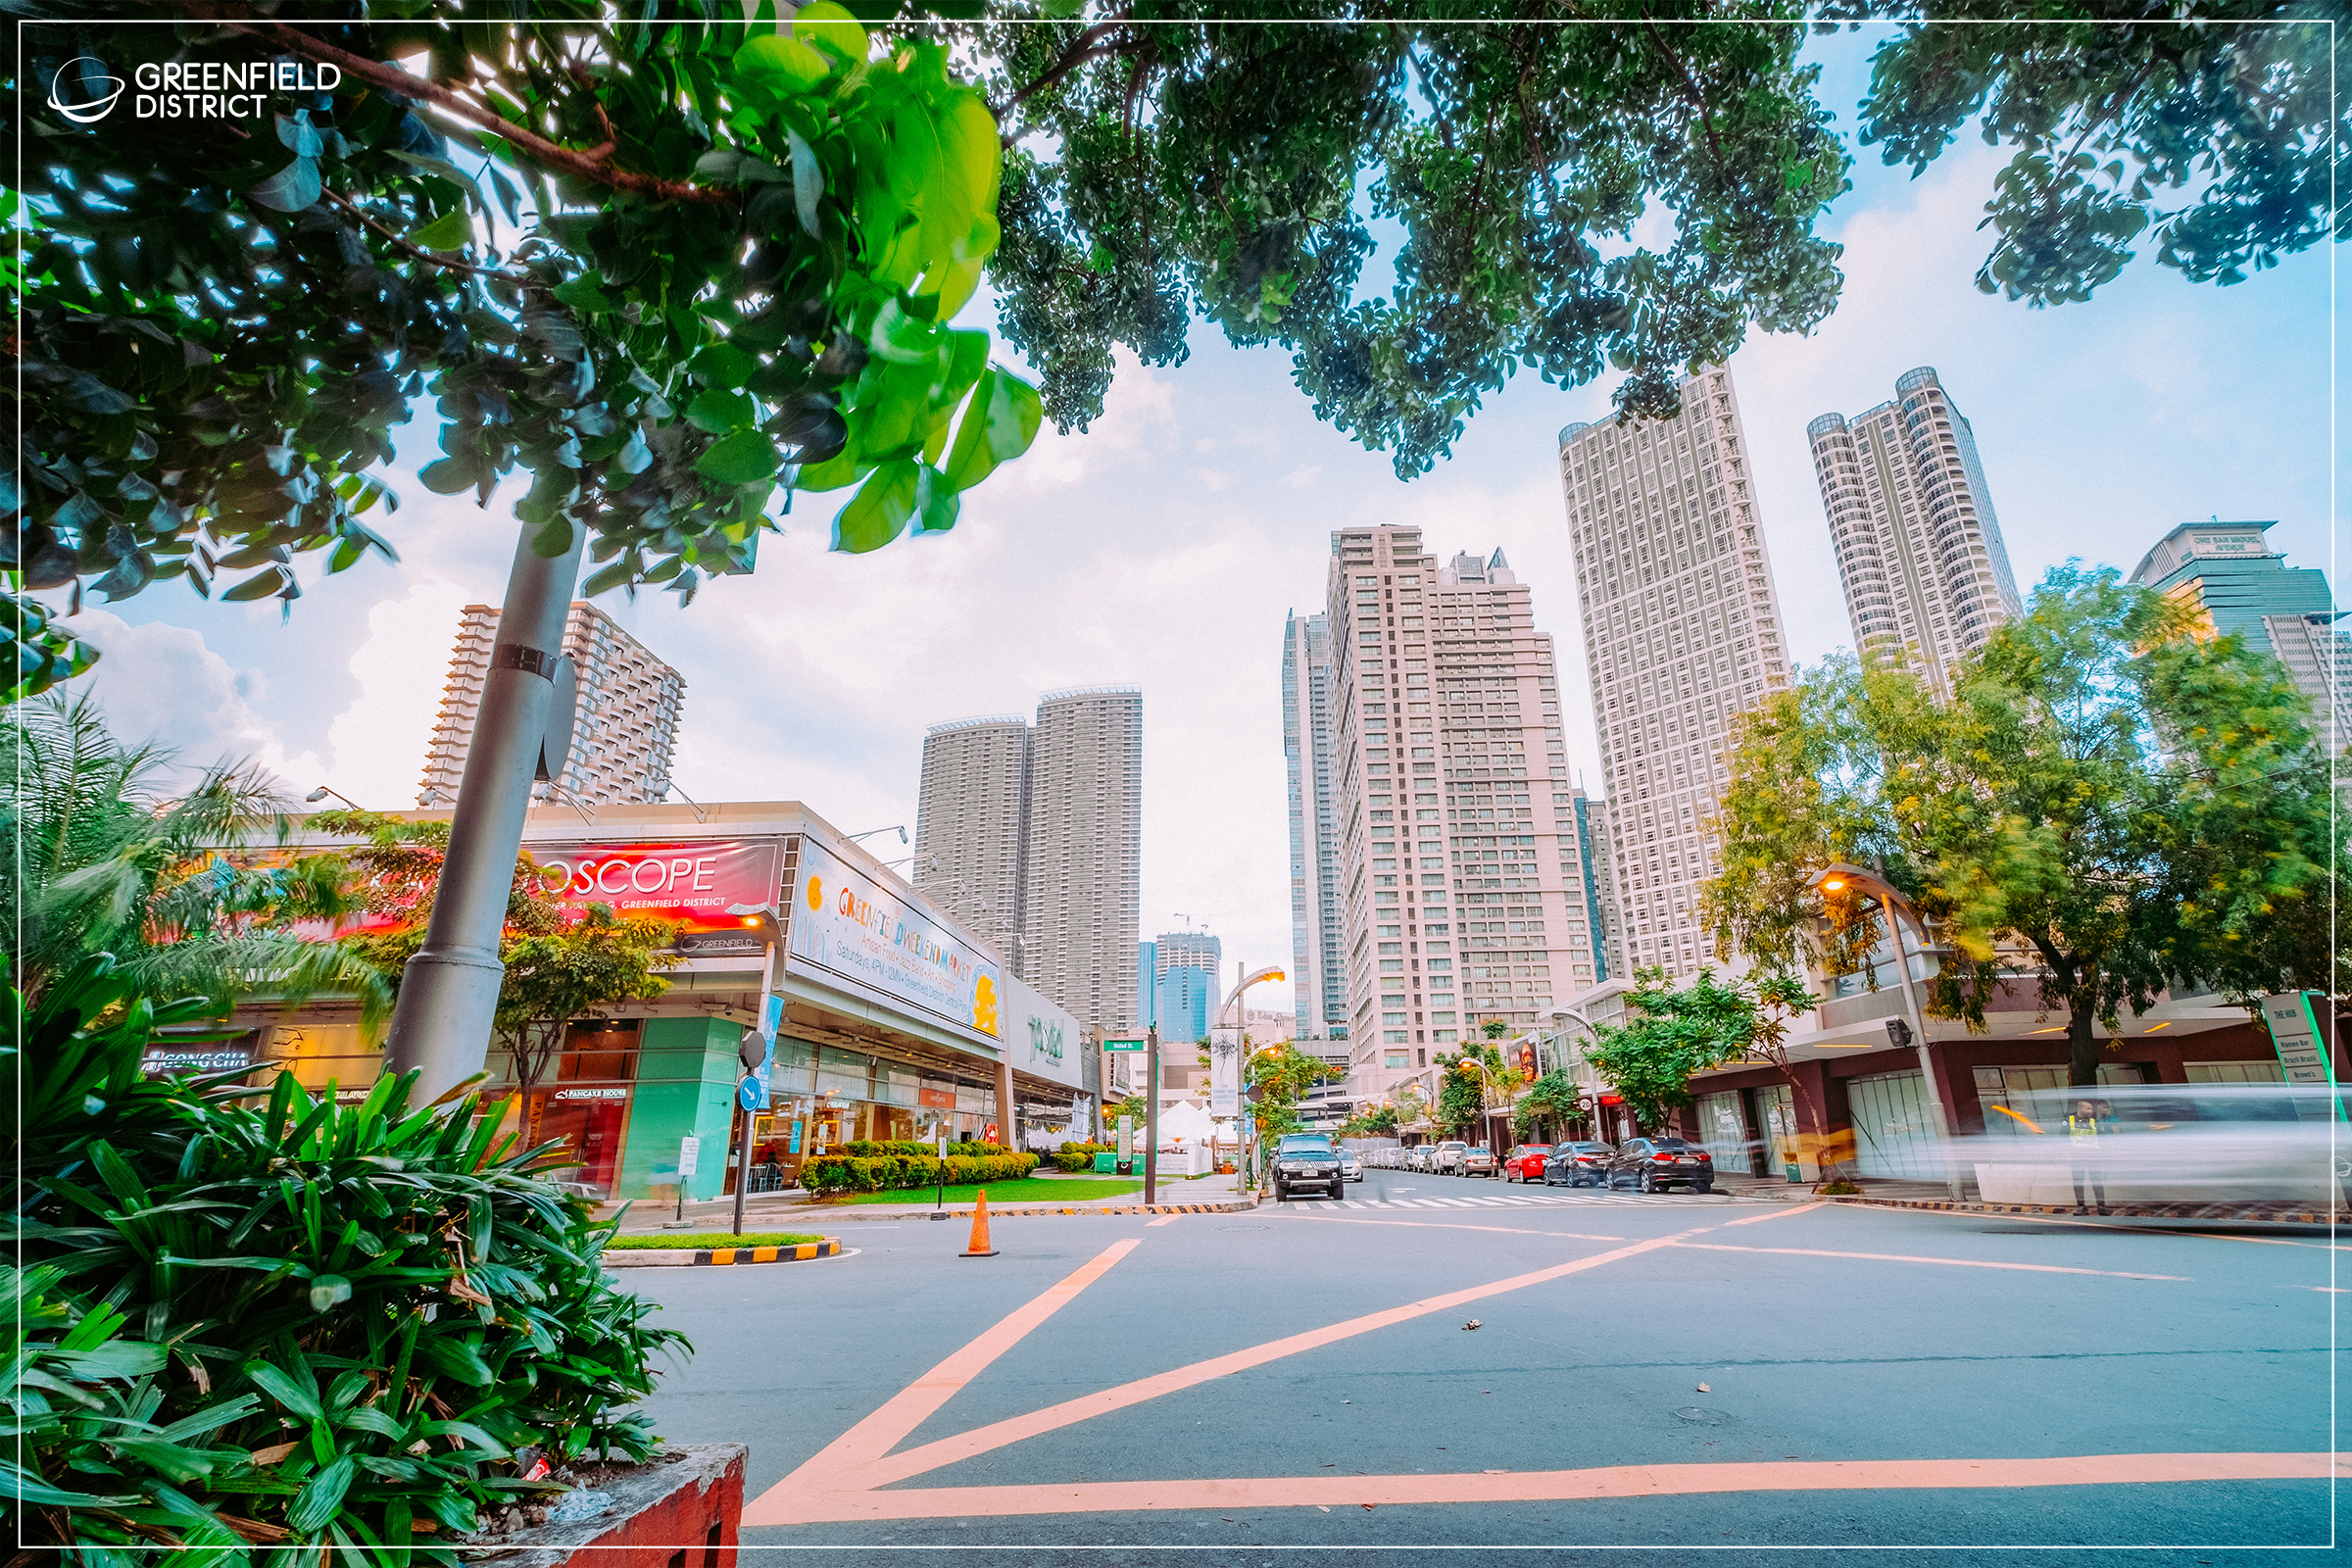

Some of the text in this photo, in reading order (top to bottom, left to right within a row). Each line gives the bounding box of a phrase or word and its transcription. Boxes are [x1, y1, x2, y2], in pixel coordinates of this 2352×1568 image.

[2230, 535, 2261, 544] MIGUEL
[523, 857, 718, 896] OSCOPE
[620, 898, 681, 909] GREENFIELD
[682, 896, 727, 907] DISTRICT
[838, 886, 971, 984] GREENFIELD WEEKEND MARKET
[702, 938, 754, 949] GREENFIELD
[860, 933, 882, 956] Artisan
[882, 943, 896, 962] Food
[899, 954, 911, 970] Jazz
[911, 958, 924, 977] Band
[836, 940, 871, 973] Saturdays,
[905, 973, 929, 997] Greenfield
[2274, 1008, 2297, 1019] THE HUB
[2300, 1054, 2317, 1063] Brazil
[567, 1088, 626, 1098] PANCAKE HOUSE
